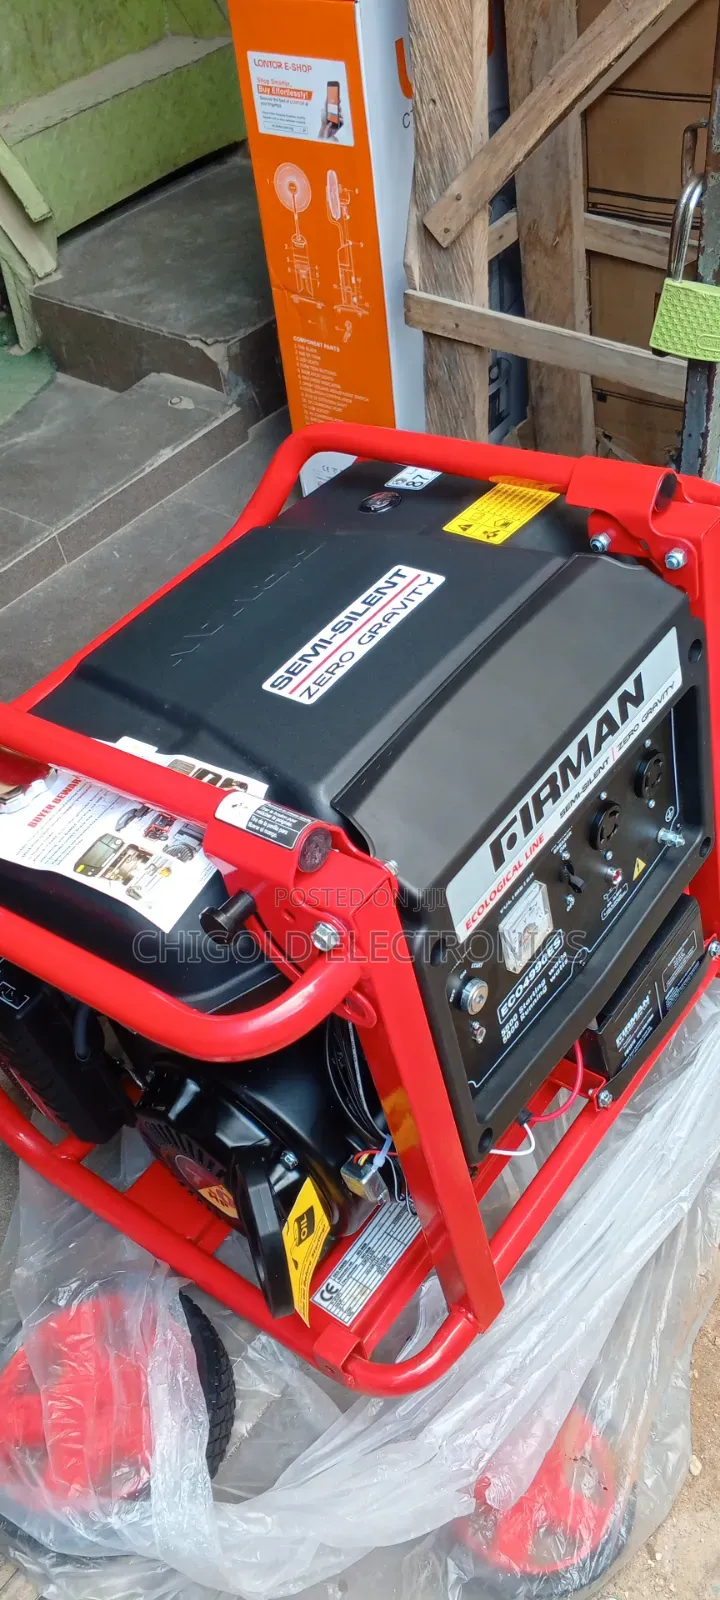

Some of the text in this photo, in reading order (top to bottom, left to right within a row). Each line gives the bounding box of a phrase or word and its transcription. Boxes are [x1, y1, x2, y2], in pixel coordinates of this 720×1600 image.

[254, 58, 312, 73] LONTOR E-SHOP
[258, 86, 270, 95] Buy
[292, 336, 322, 348] COMPONENT
[323, 343, 340, 352] PARTS
[269, 568, 408, 691] SEMI-SILENT
[299, 650, 355, 700] ZERO
[357, 576, 434, 646] GRAVITY
[488, 671, 645, 874] FIRMAN
[559, 756, 611, 819] SEMI-SILENT
[617, 722, 640, 753] ZERO
[641, 680, 677, 724] GRAVITY
[27, 775, 82, 828] BUYER BEWAR
[465, 860, 524, 932] ECOLOGICAL
[524, 832, 545, 860] LINE
[500, 936, 560, 1018] ECO4990ES
[520, 984, 548, 1022] Running
[501, 1013, 518, 1037] 5500
[518, 978, 546, 1014] Starting
[300, 1213, 308, 1240] OIL
[320, 1282, 339, 1302] CE
